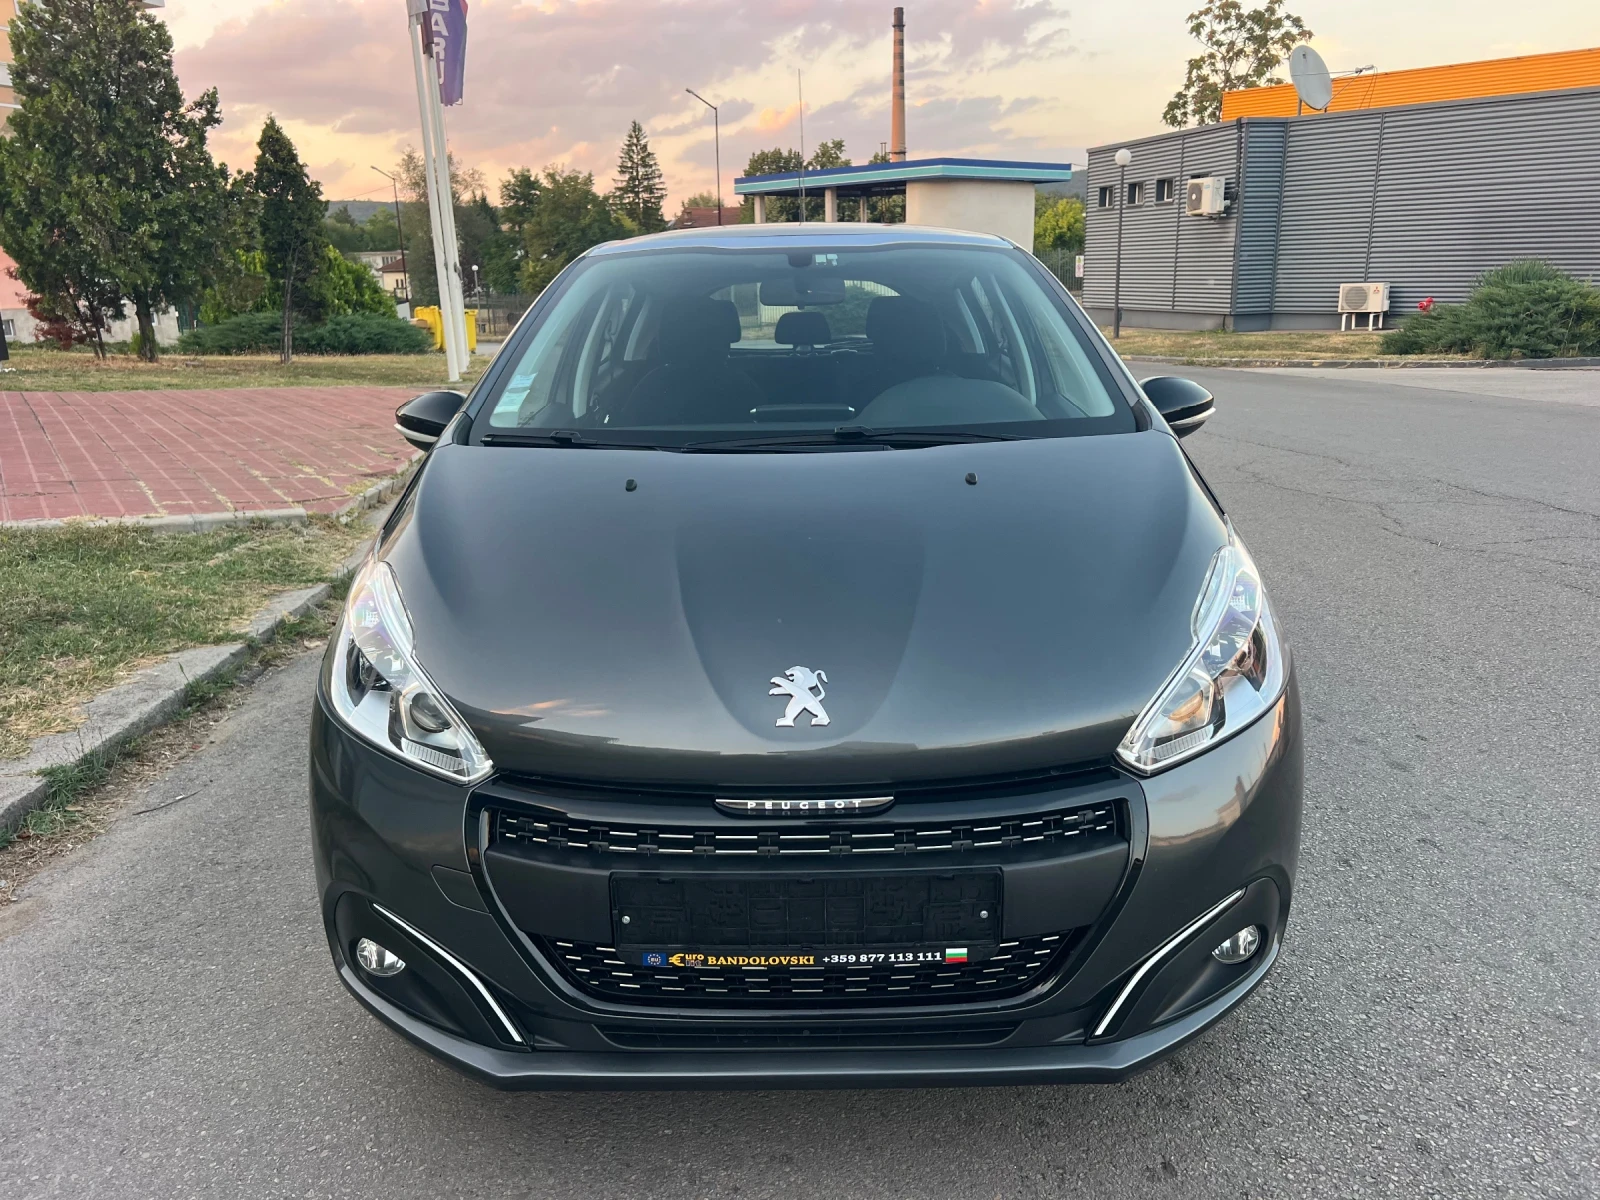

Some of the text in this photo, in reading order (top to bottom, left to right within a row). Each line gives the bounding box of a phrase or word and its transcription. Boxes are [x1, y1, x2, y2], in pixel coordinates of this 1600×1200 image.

[747, 800, 861, 810] PEUGEOT
[707, 956, 815, 966] BANDOLOVSKI
[822, 954, 856, 963] +359
[859, 953, 885, 963] 877
[888, 952, 914, 962] 113
[917, 952, 942, 961] 111
